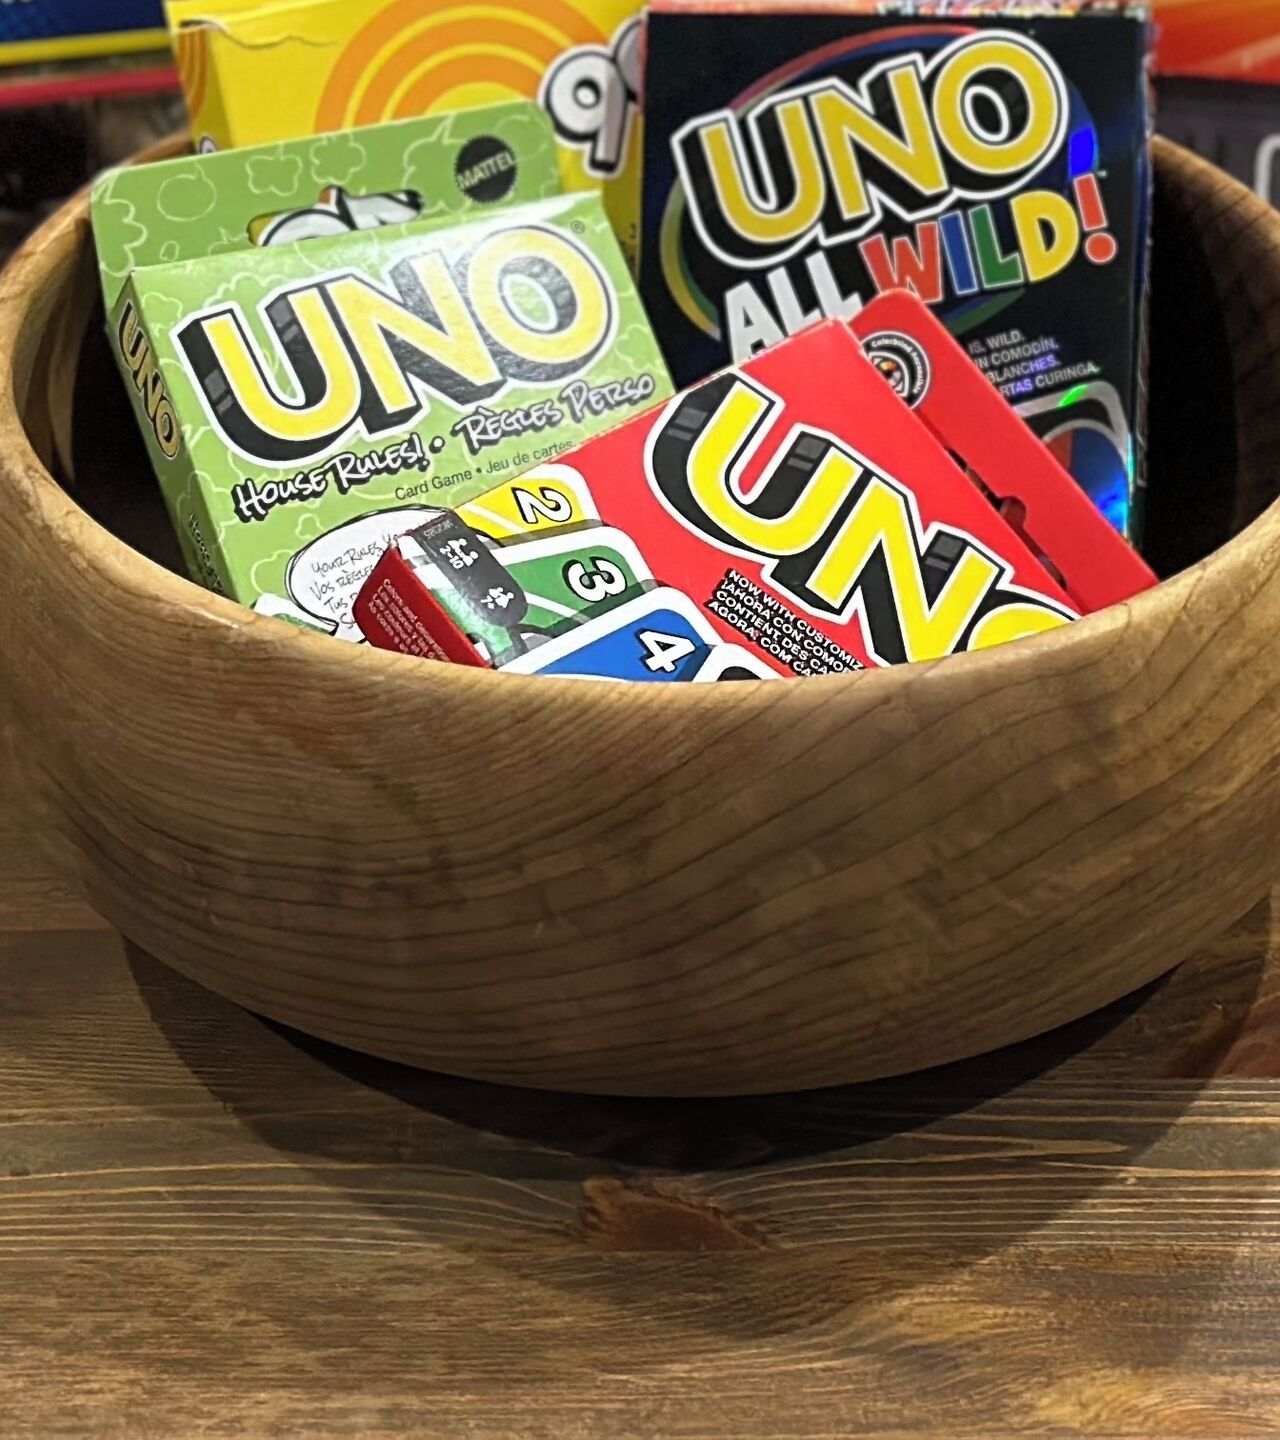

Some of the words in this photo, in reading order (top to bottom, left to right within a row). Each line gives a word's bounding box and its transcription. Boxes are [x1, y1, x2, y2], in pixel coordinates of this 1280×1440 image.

[457, 149, 517, 189] MATTEL
[670, 29, 1070, 268] UNO
[723, 251, 863, 366] ALL
[858, 171, 1118, 307] WILD!
[169, 219, 619, 462] UNO
[119, 300, 180, 459] UNO
[453, 400, 561, 454] RÈGLES
[561, 373, 655, 419] PERSO
[232, 466, 328, 523] HOUSE
[325, 434, 427, 492] RULES!
[485, 457, 510, 474] Jeu
[512, 449, 530, 466] de
[394, 481, 430, 502] Card
[430, 465, 472, 492] Game
[516, 486, 573, 526] 2
[438, 545, 466, 571] 2-10
[309, 576, 335, 602] VOS
[566, 558, 629, 604] 3
[716, 590, 782, 640] CONTIENT
[781, 637, 810, 661] DES
[763, 594, 796, 623] WITH
[773, 616, 803, 641] CON
[635, 629, 697, 672] 4
[760, 637, 794, 664] COM
